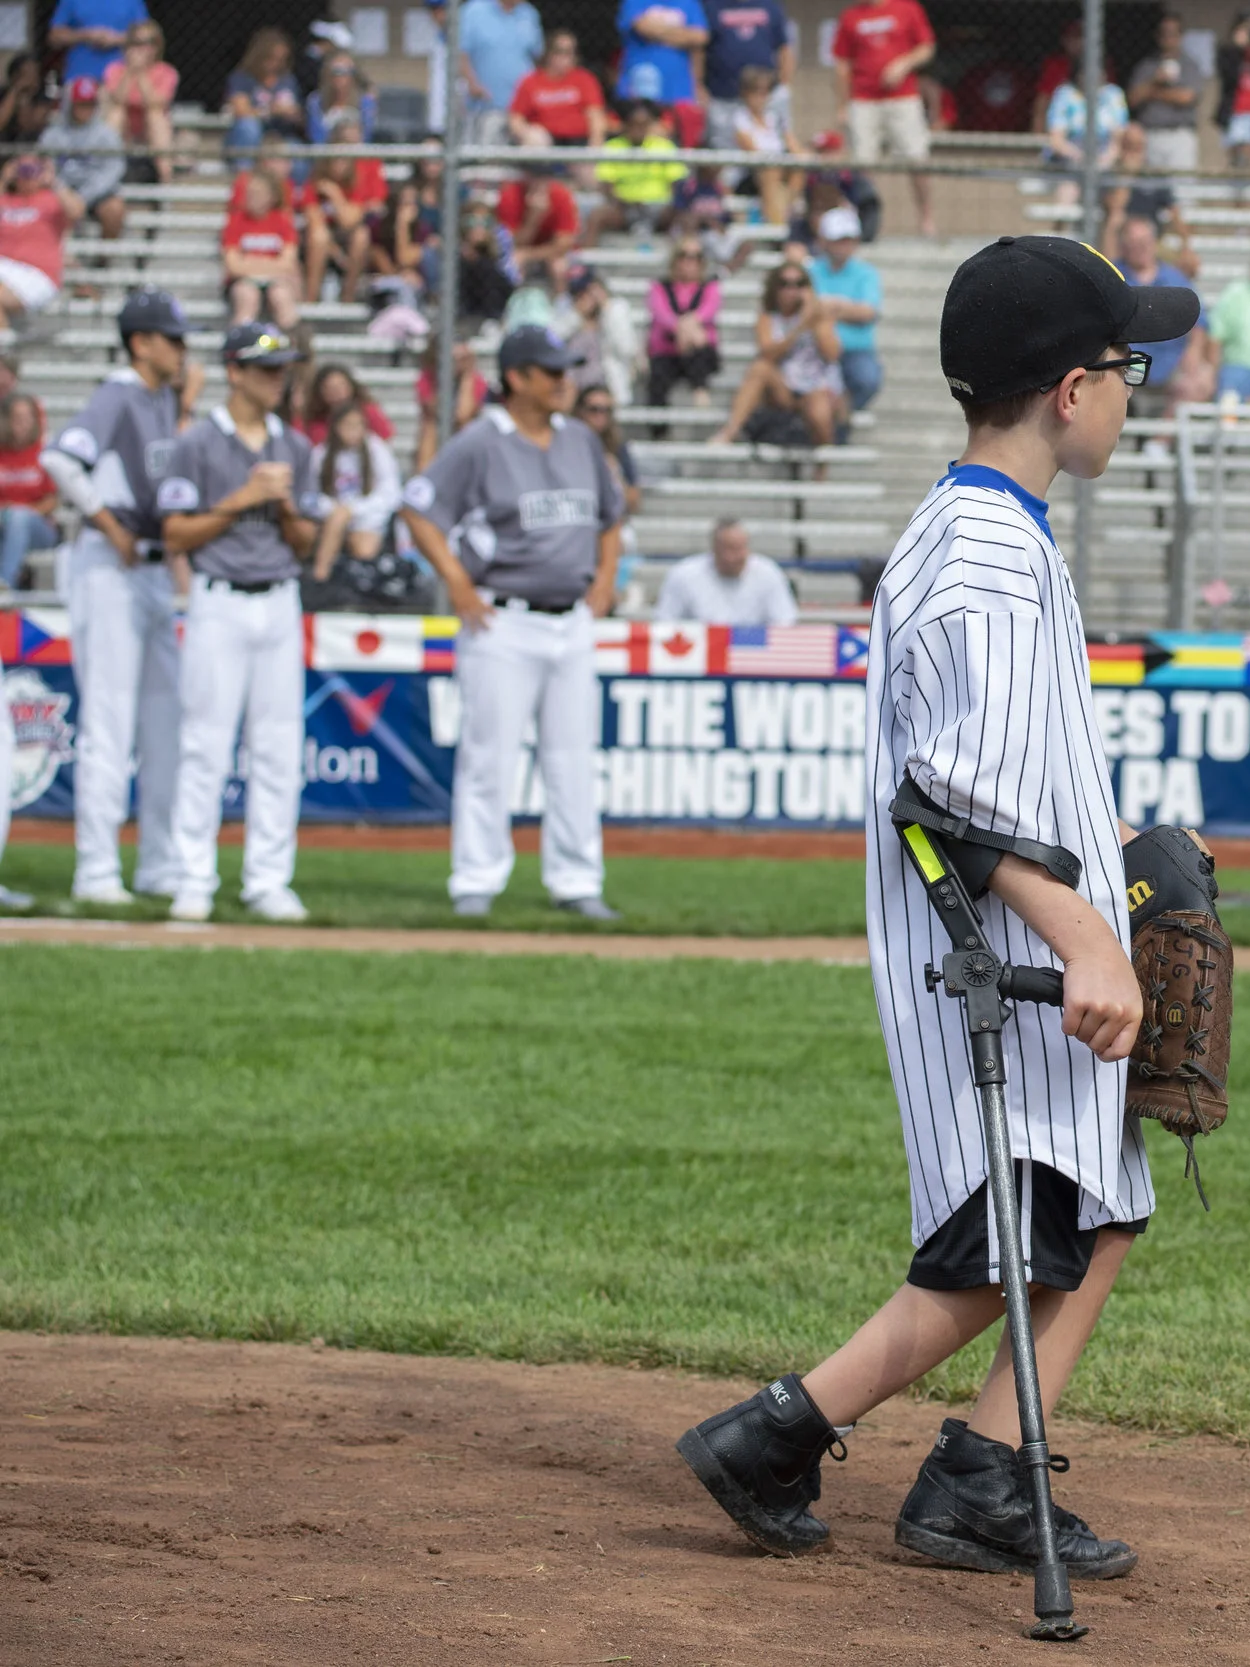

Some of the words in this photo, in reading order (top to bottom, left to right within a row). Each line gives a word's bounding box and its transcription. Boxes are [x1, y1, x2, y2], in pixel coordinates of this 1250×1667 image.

[609, 679, 726, 750] THE
[732, 681, 866, 751] WOR
[1119, 757, 1206, 829] PA
[768, 1380, 791, 1406] NIKE
